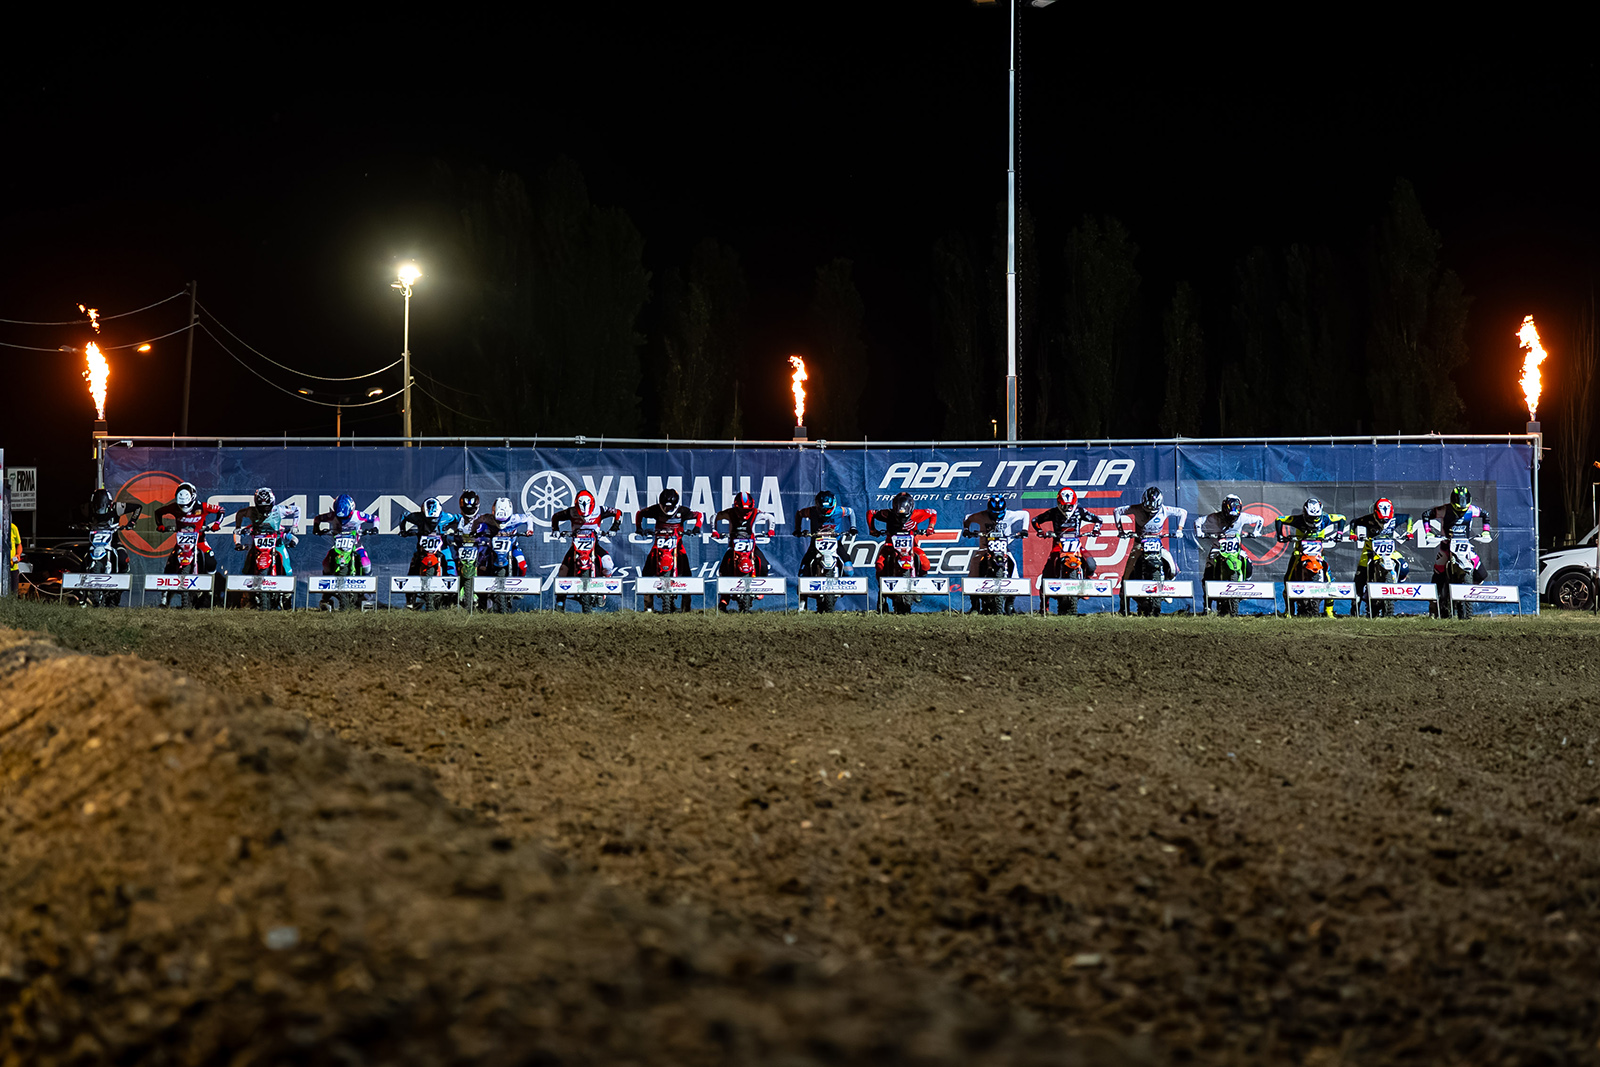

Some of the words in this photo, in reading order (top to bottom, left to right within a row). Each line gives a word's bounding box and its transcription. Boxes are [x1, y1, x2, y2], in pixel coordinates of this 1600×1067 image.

[878, 461, 982, 488] ABF
[987, 459, 1135, 487] ITALIA
[582, 475, 785, 524] YAMAHA
[93, 533, 111, 543] 27
[257, 538, 275, 547] 945
[494, 540, 509, 551] 31
[578, 541, 592, 549] 72
[734, 541, 753, 551] 81
[819, 541, 836, 550] 37
[988, 540, 1007, 551] 338
[1302, 545, 1321, 554] 22
[1374, 544, 1393, 553] 709
[1455, 543, 1468, 552] 19
[1381, 585, 1421, 597] BILDEX
